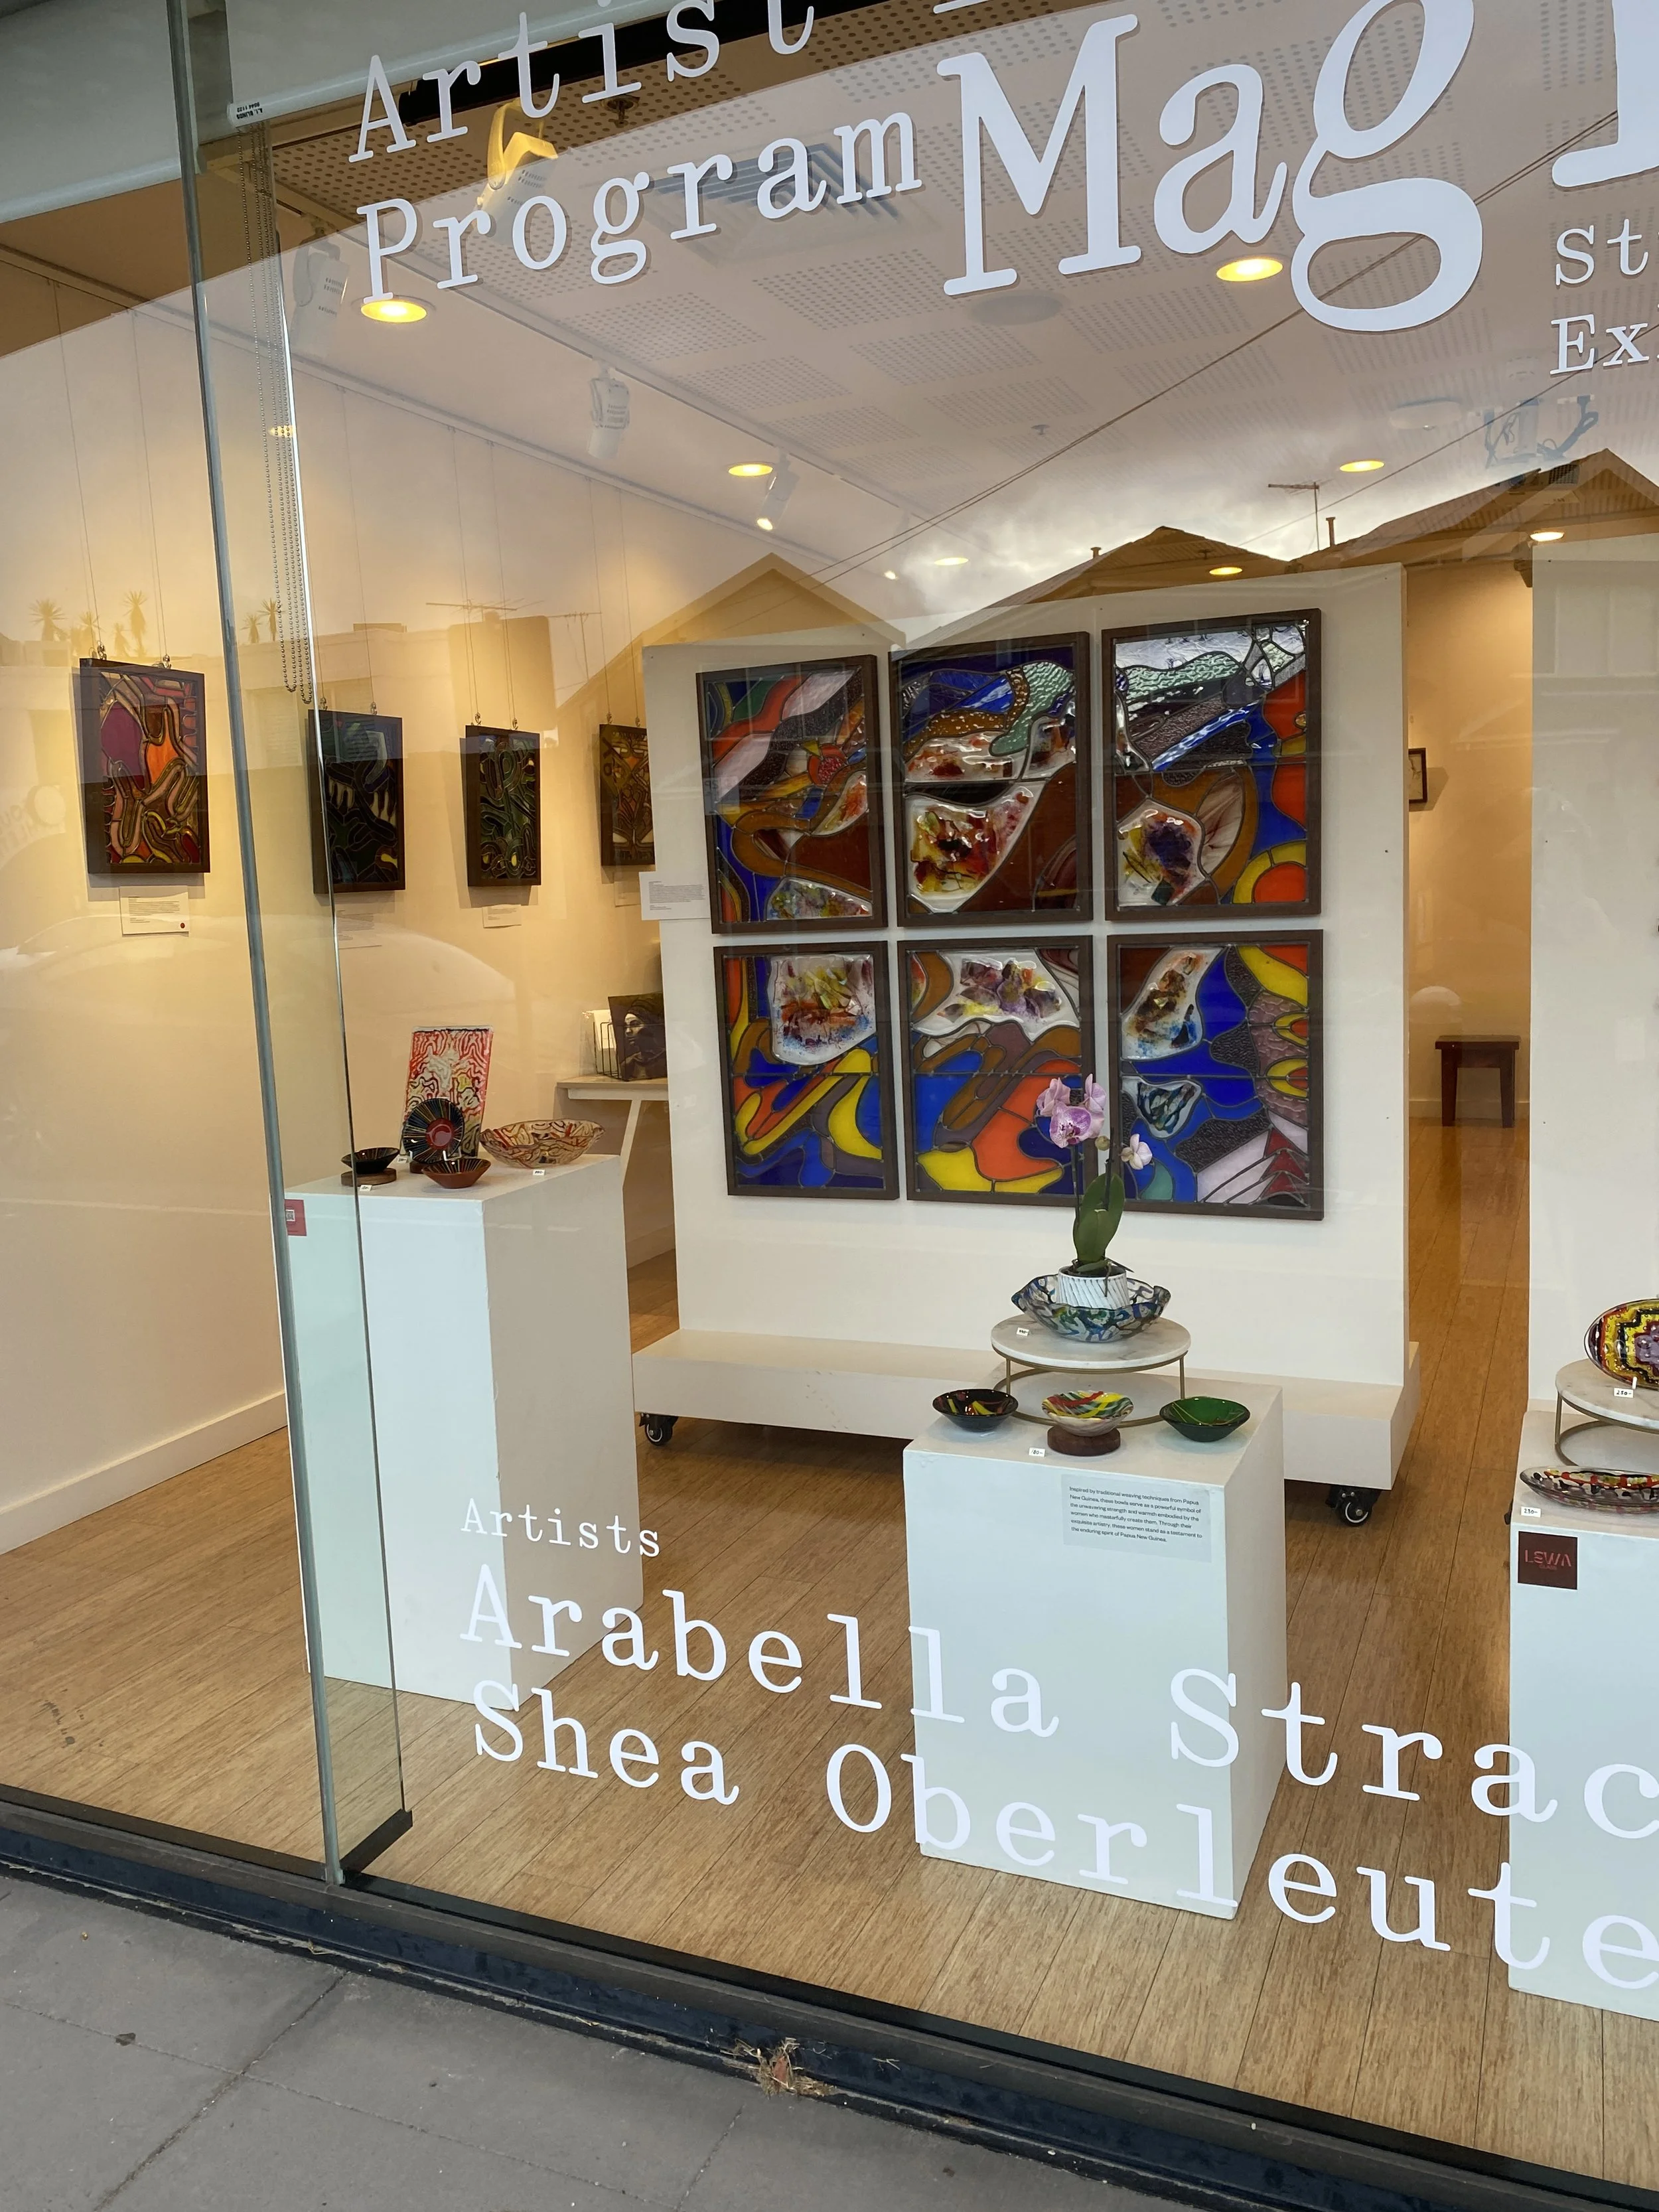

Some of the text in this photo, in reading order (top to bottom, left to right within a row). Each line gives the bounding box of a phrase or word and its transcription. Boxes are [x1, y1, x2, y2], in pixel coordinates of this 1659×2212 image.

[236, 110, 254, 119] BLINDS
[356, 110, 922, 303] Program
[1555, 218, 1659, 286] St
[1550, 304, 1659, 375] Ex
[461, 1498, 660, 1557] Artists
[459, 1564, 1659, 1838] Arabella Strac
[472, 1679, 1659, 1989] Shea Oberleute
